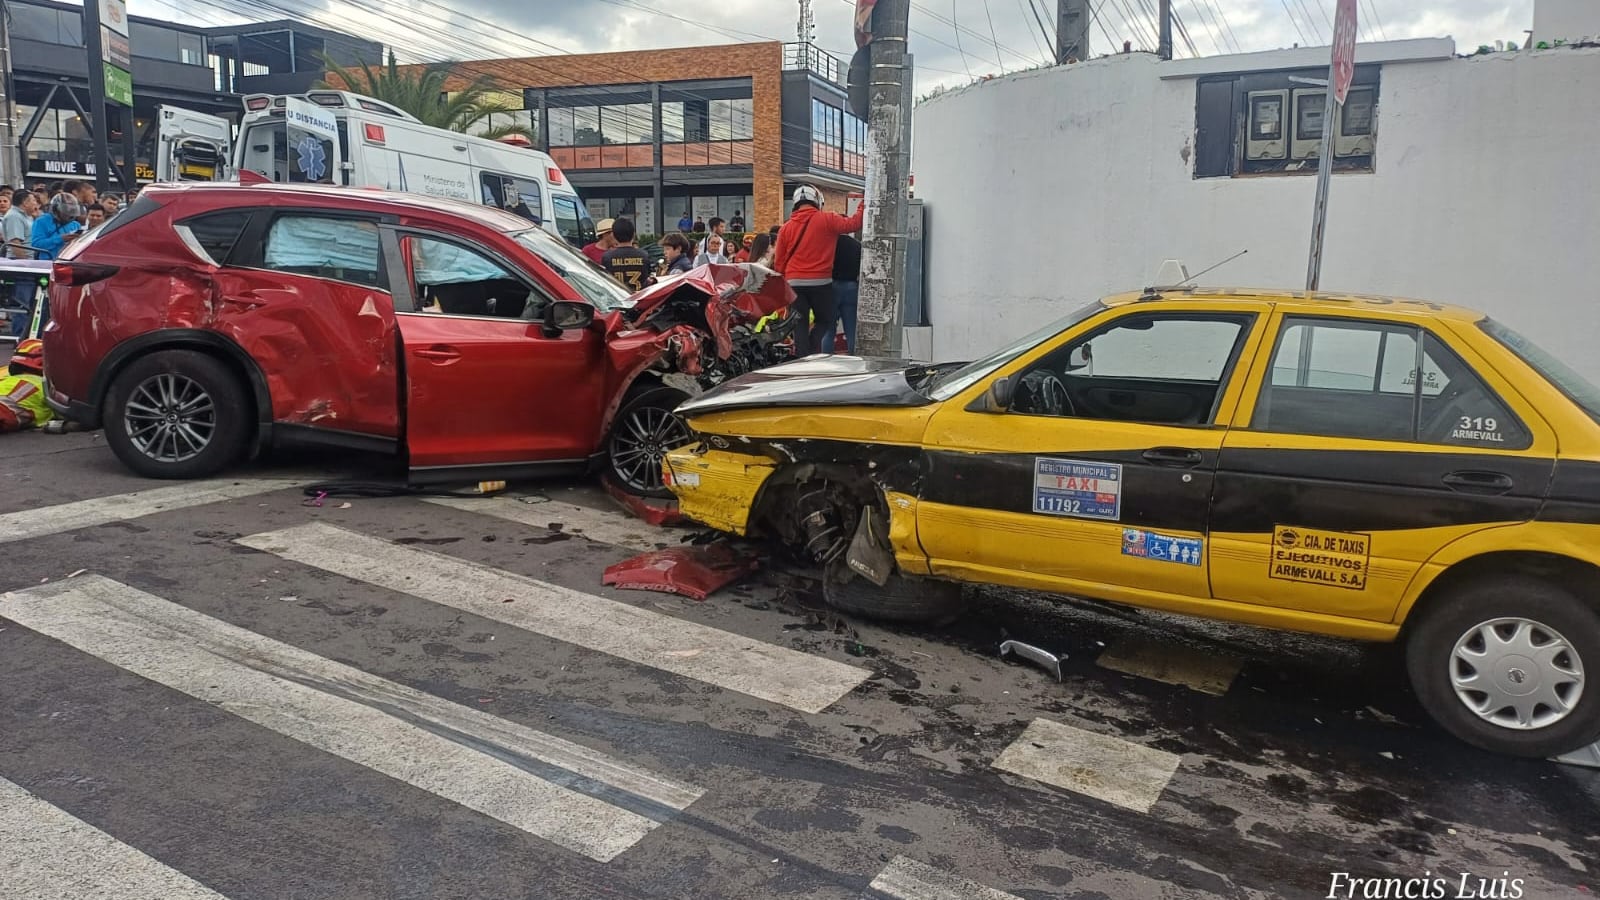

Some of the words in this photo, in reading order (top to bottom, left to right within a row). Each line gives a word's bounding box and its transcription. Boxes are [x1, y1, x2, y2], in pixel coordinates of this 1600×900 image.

[296, 112, 336, 132] DISTANCIA
[44, 160, 77, 173] MOVIE
[1459, 416, 1497, 431] 319
[1452, 430, 1504, 442] ARMEVALL
[1072, 465, 1108, 477] MUNICIPAL
[1056, 476, 1099, 491] TAXI
[1039, 497, 1080, 513] 11792
[1304, 534, 1321, 549] CIA.
[1324, 537, 1336, 550] DE
[1338, 538, 1364, 554] TAXIS
[1276, 550, 1362, 570] EJECUTIVOS
[1275, 564, 1337, 582] ARMEVALL
[1340, 573, 1362, 586] S.A.
